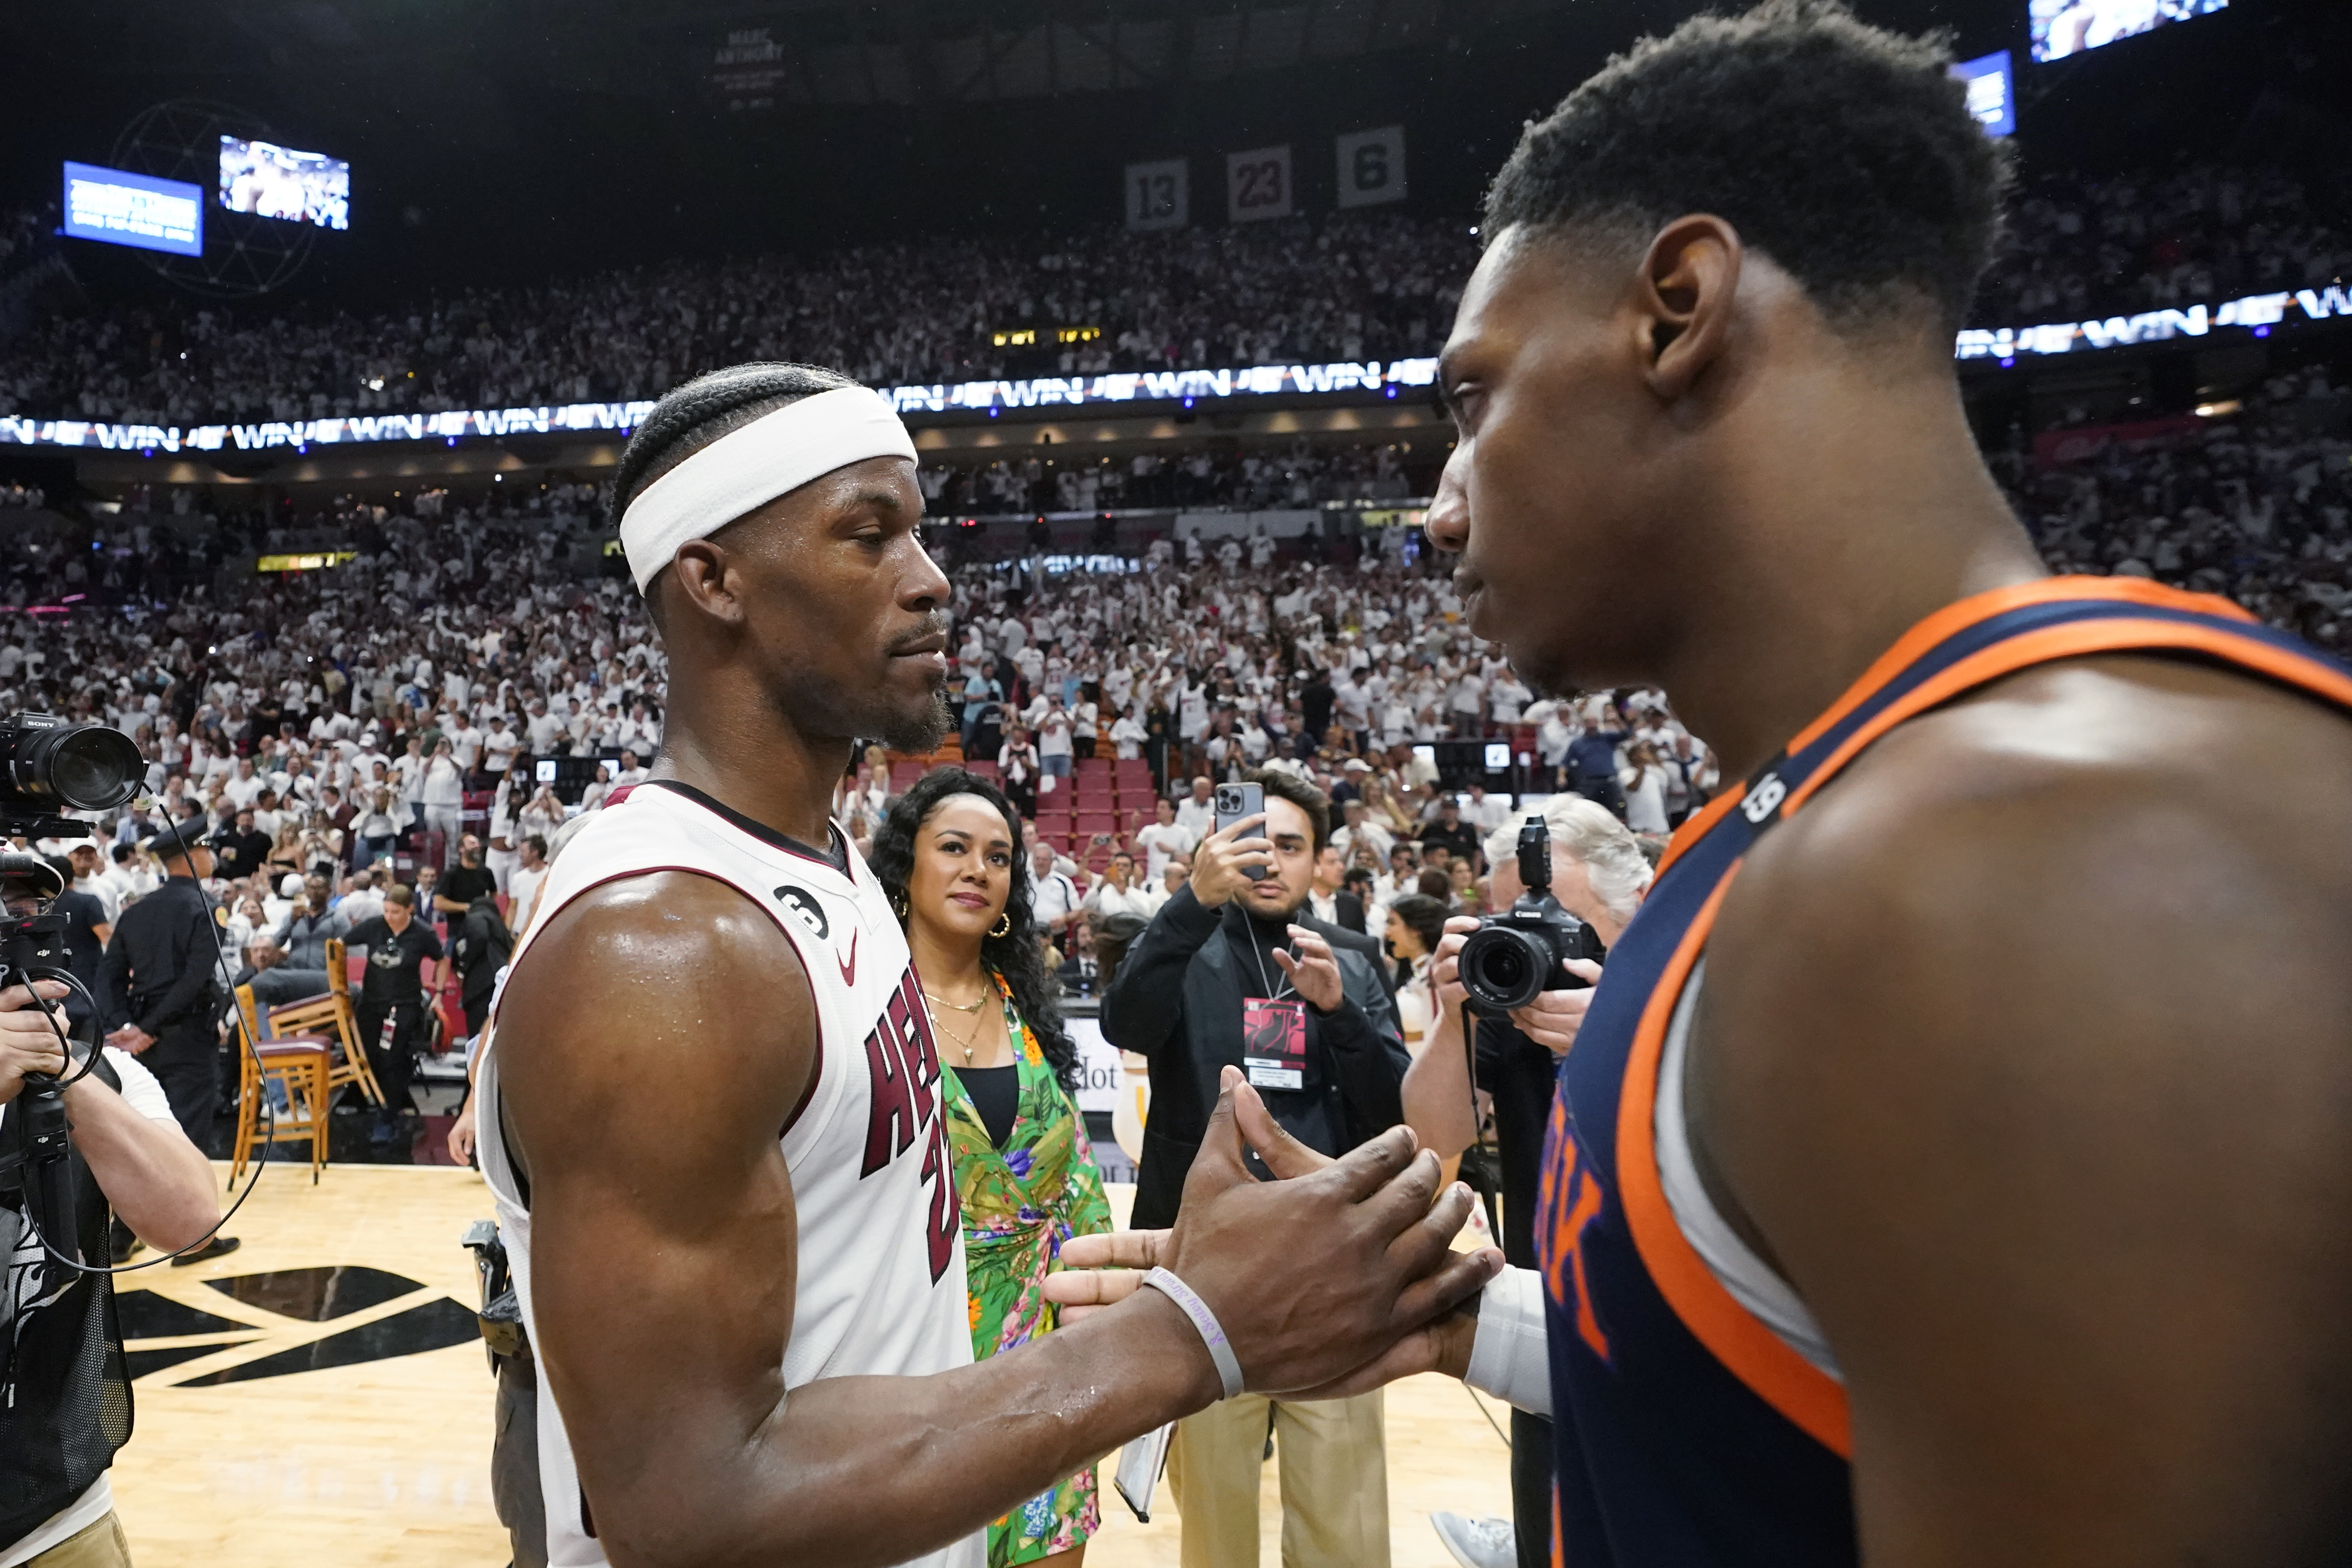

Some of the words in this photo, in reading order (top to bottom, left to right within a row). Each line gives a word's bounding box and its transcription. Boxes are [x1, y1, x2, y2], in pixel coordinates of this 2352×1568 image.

[1236, 159, 1282, 209] 23
[1353, 143, 1389, 191] 6
[1136, 174, 1176, 220] 13
[2082, 305, 2208, 347] WIN
[999, 377, 1083, 406] WIN
[1143, 370, 1230, 397] WIN
[1290, 362, 1380, 391] WIN
[96, 423, 179, 451] WIN
[232, 422, 303, 448] WIN
[349, 414, 421, 440] WIN
[474, 408, 548, 435] WIN
[1740, 771, 1787, 823] 6
